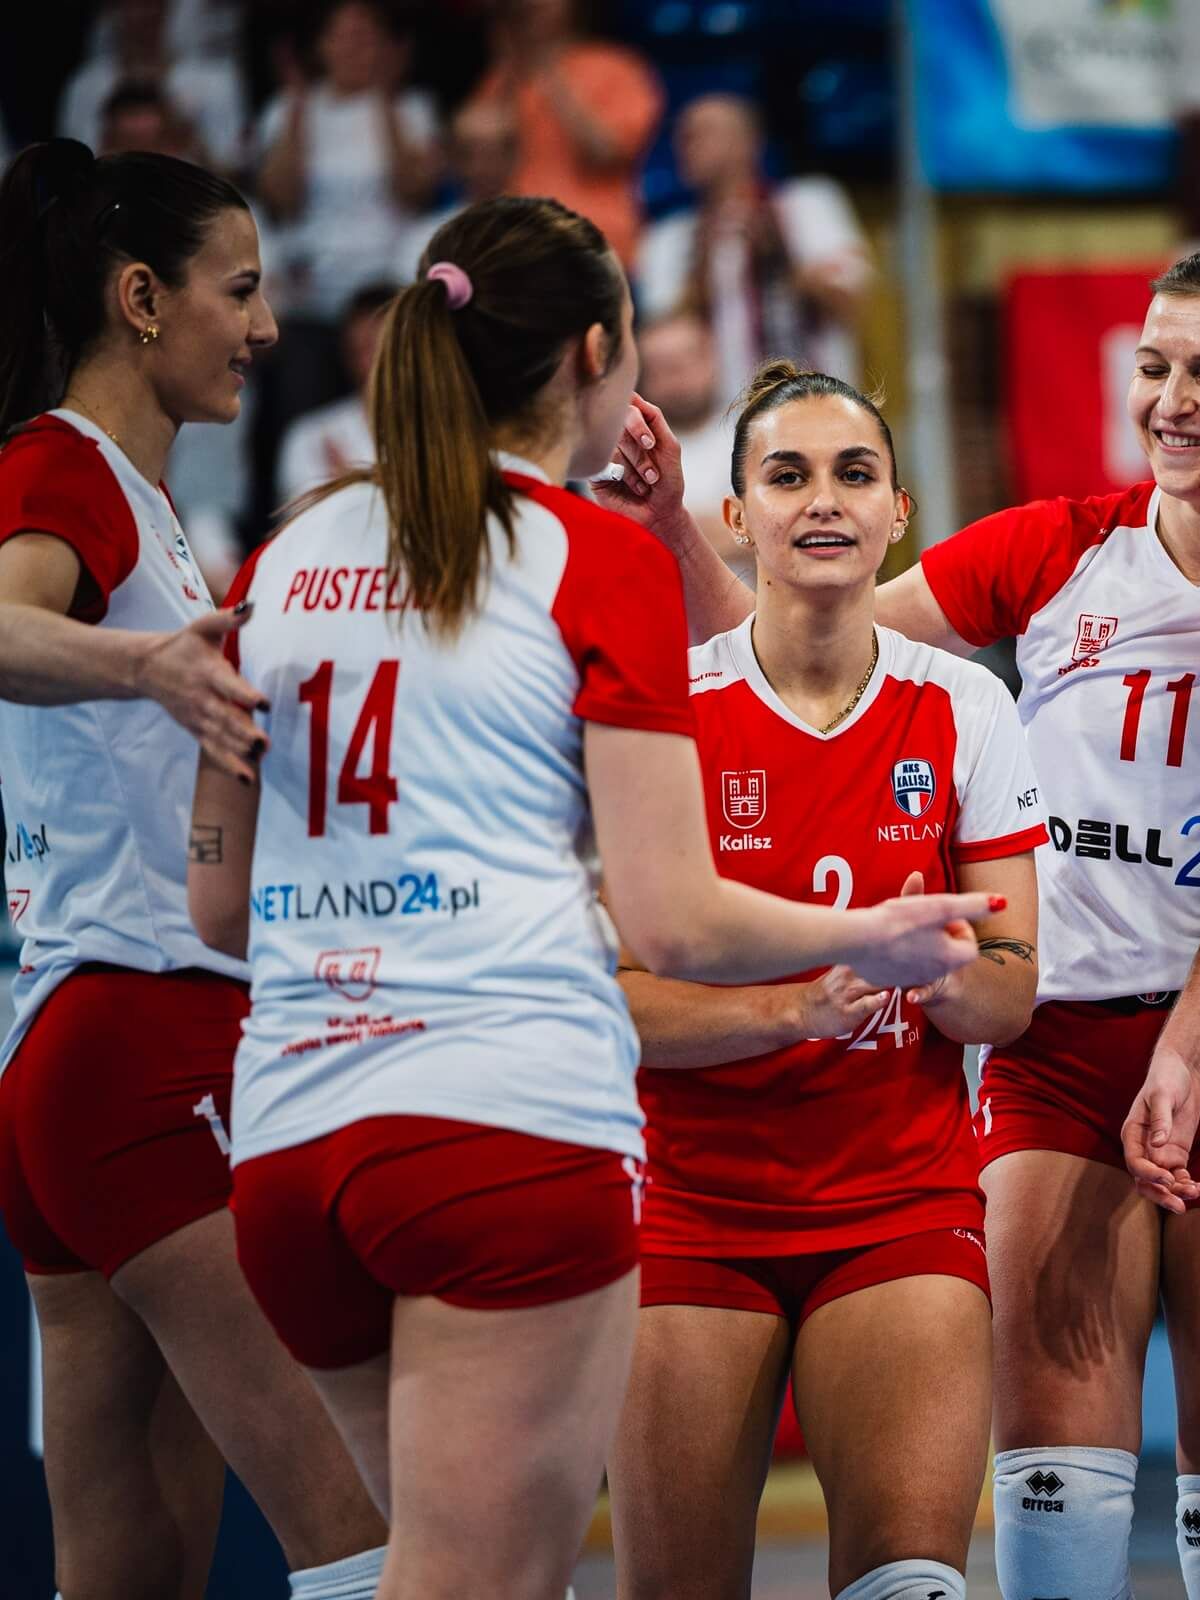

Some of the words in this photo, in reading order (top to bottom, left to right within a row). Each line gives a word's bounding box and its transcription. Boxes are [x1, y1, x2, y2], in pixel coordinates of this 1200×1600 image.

[298, 659, 400, 838] 14
[1119, 669, 1197, 768] 11
[1016, 787, 1039, 811] NET
[719, 834, 772, 851] Kalisz
